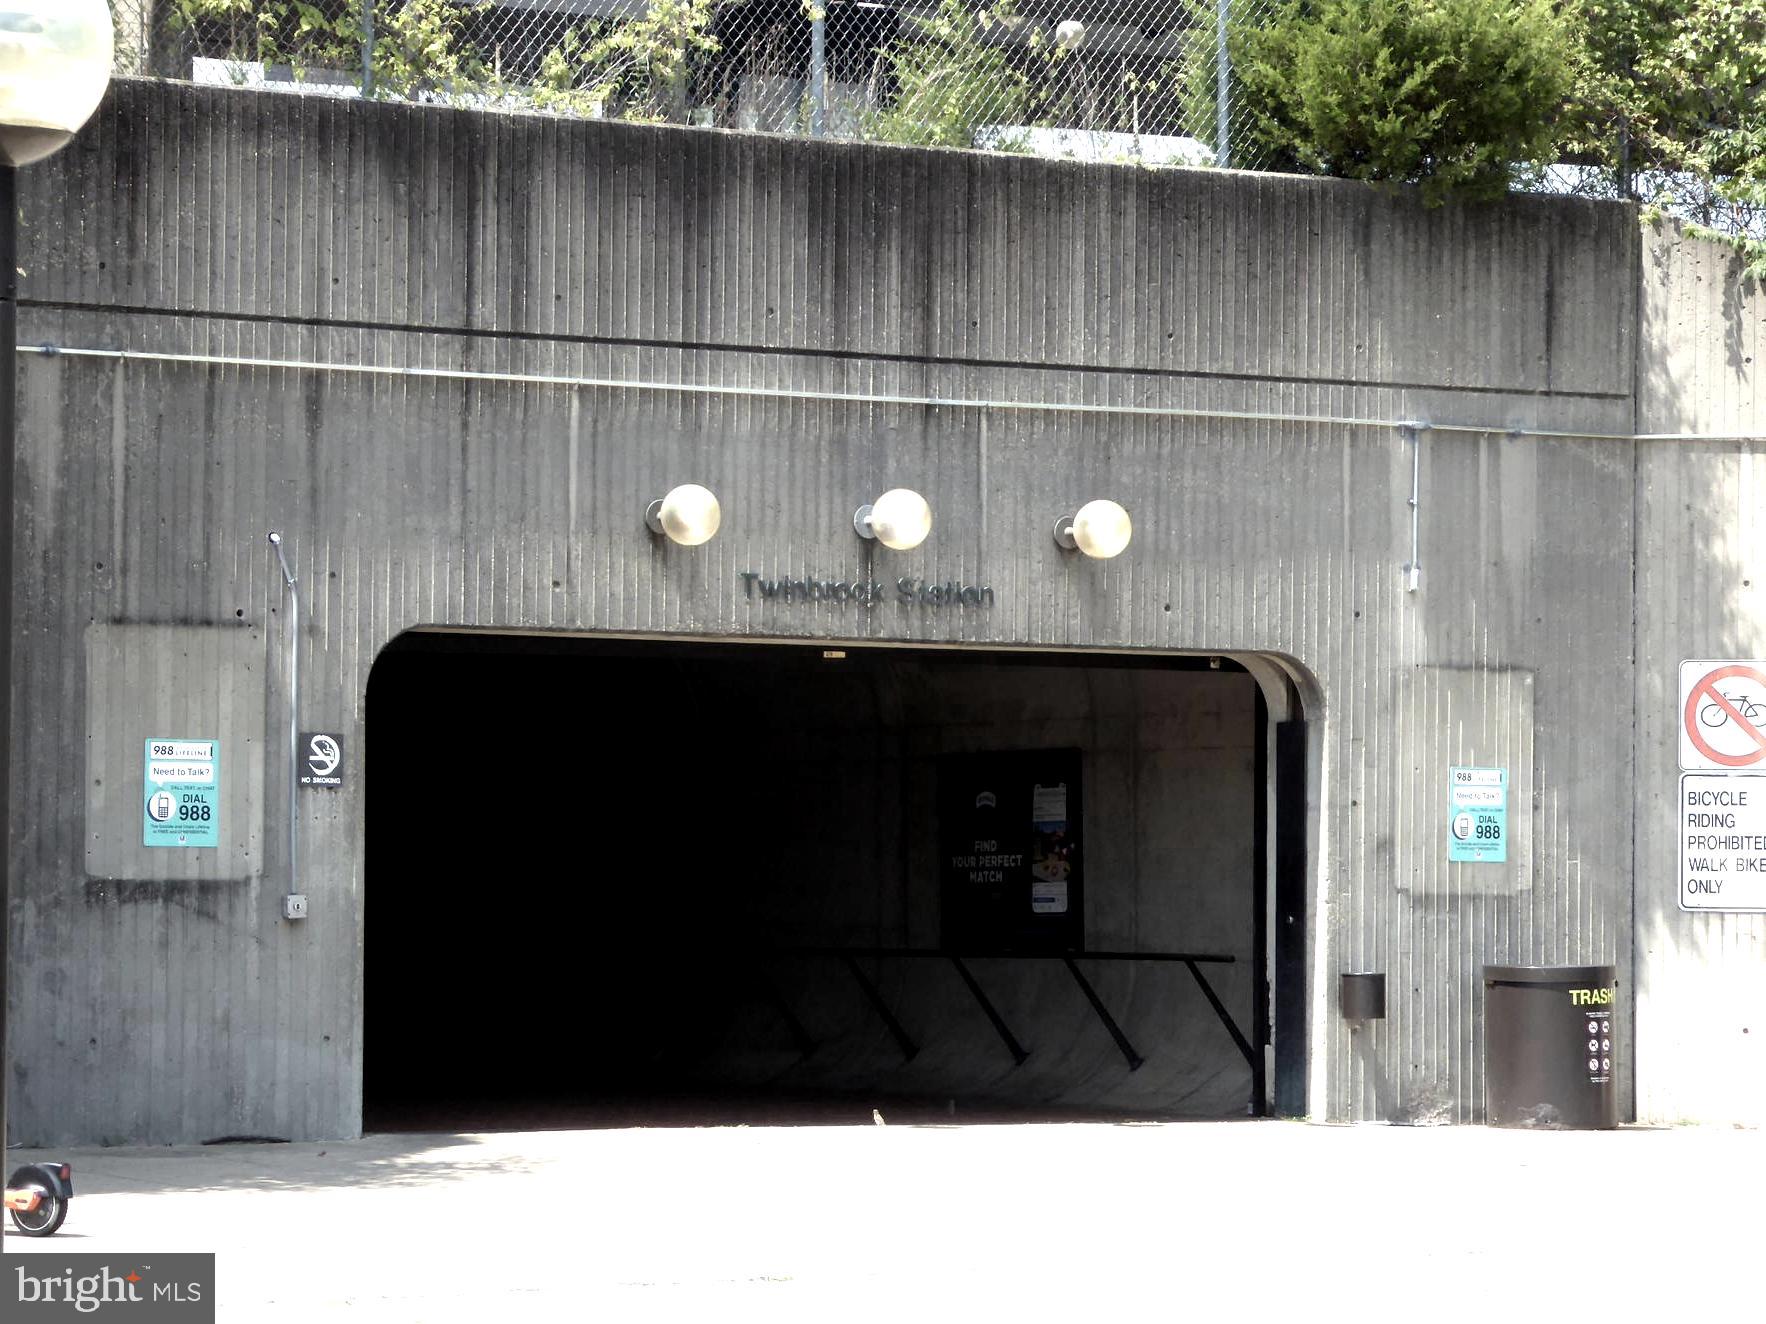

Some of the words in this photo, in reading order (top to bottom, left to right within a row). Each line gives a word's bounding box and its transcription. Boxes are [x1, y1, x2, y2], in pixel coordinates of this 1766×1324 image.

[739, 572, 883, 602] Twinbrook
[898, 576, 994, 605] Station
[153, 745, 174, 756] 988
[153, 767, 175, 776] Need
[177, 768, 186, 776] to
[188, 768, 210, 776] Talk?
[1456, 772, 1472, 782] 988
[301, 776, 311, 784] NO
[312, 776, 341, 784] SMOKING
[182, 793, 207, 804] DIAL
[1688, 791, 1747, 806] BICYCLE
[179, 805, 211, 821] 988
[1478, 815, 1498, 824] DIAL
[1688, 813, 1735, 828] RIDING
[1476, 825, 1500, 839] 988
[974, 840, 997, 852] FIND
[1688, 835, 1766, 850] PROHIBITE
[952, 856, 977, 868] YOUR
[978, 854, 1023, 868] PERFECT
[1688, 857, 1728, 872] WALK
[969, 871, 1003, 883] MATCH
[1687, 879, 1723, 894] ONLY
[1569, 987, 1613, 1006] TRASH
